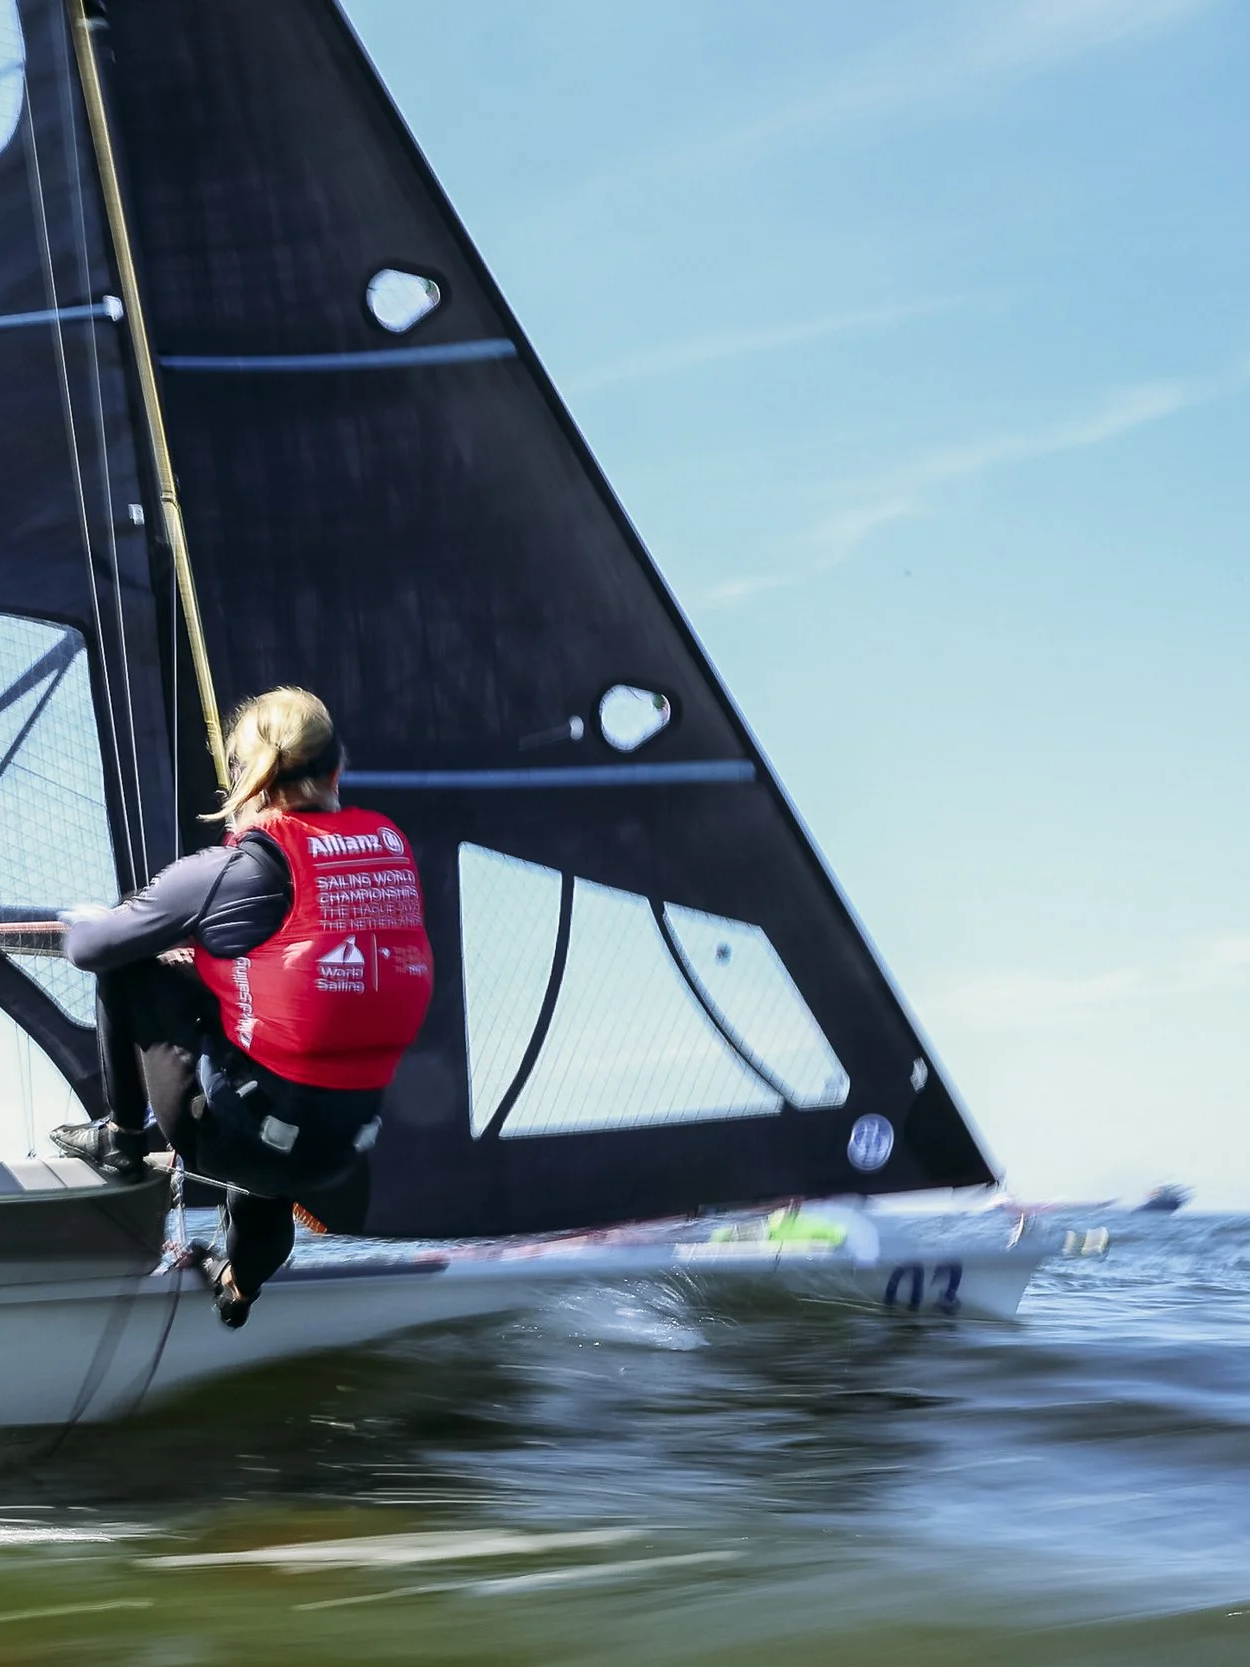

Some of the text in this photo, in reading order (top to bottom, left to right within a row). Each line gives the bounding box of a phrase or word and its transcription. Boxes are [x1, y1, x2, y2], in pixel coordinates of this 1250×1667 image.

[307, 833, 382, 857] Allianz
[316, 869, 416, 890] SAILING WORLD
[316, 885, 419, 904] CHAMPIONSHIPS
[318, 966, 364, 979] World
[316, 978, 365, 994] Sailing
